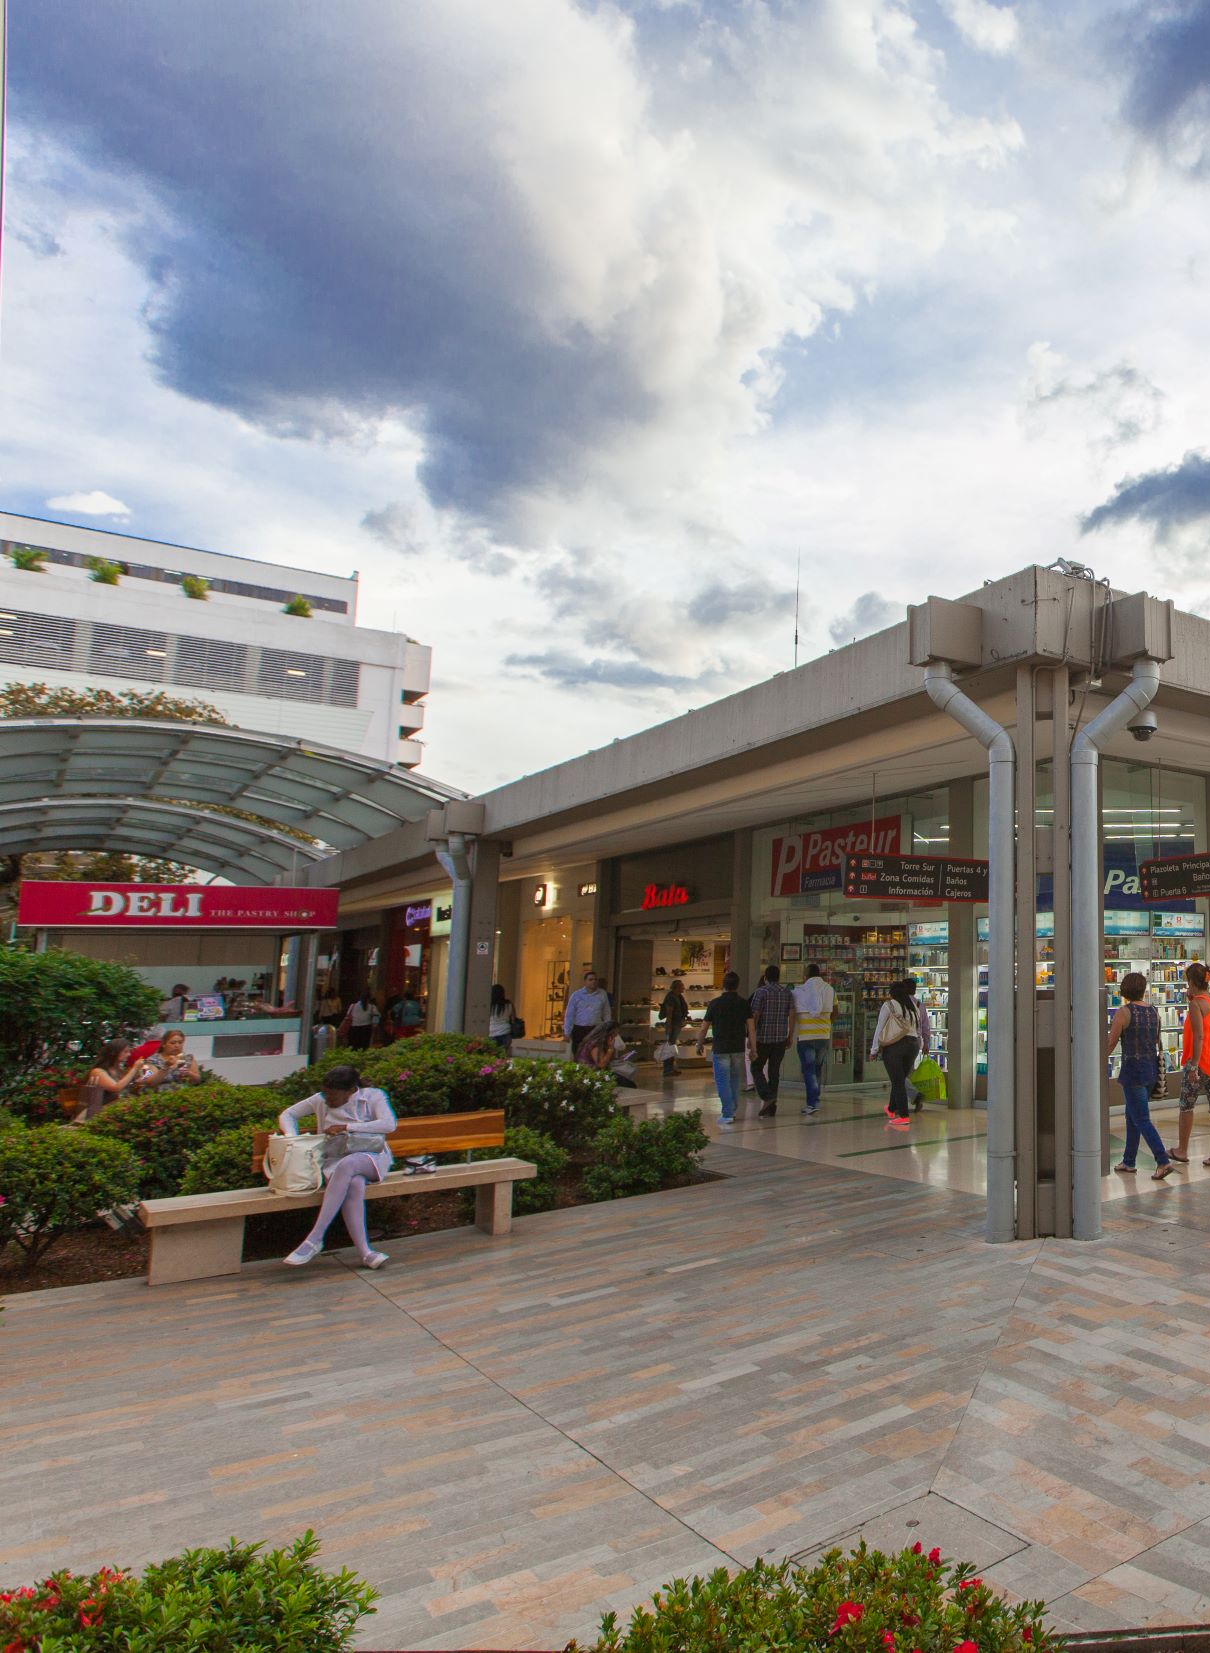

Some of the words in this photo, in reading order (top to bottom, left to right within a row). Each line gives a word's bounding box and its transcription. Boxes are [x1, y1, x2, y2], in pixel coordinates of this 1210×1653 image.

[806, 828, 897, 868] Pasteur
[900, 861, 920, 871] Torre
[922, 863, 936, 871] Sur
[947, 864, 973, 874] Puertas
[976, 866, 981, 874] 4
[1150, 864, 1179, 874] Plazoleta
[880, 873, 899, 882] Zona
[902, 873, 934, 884] Comidas
[946, 876, 967, 885] Baños
[888, 886, 934, 896] Información
[945, 889, 972, 898] Cajeros
[1160, 888, 1181, 897] Puerta
[640, 883, 688, 910] Bata
[86, 891, 204, 917] DELI
[209, 909, 236, 917] THE
[237, 910, 278, 918] PASTRY
